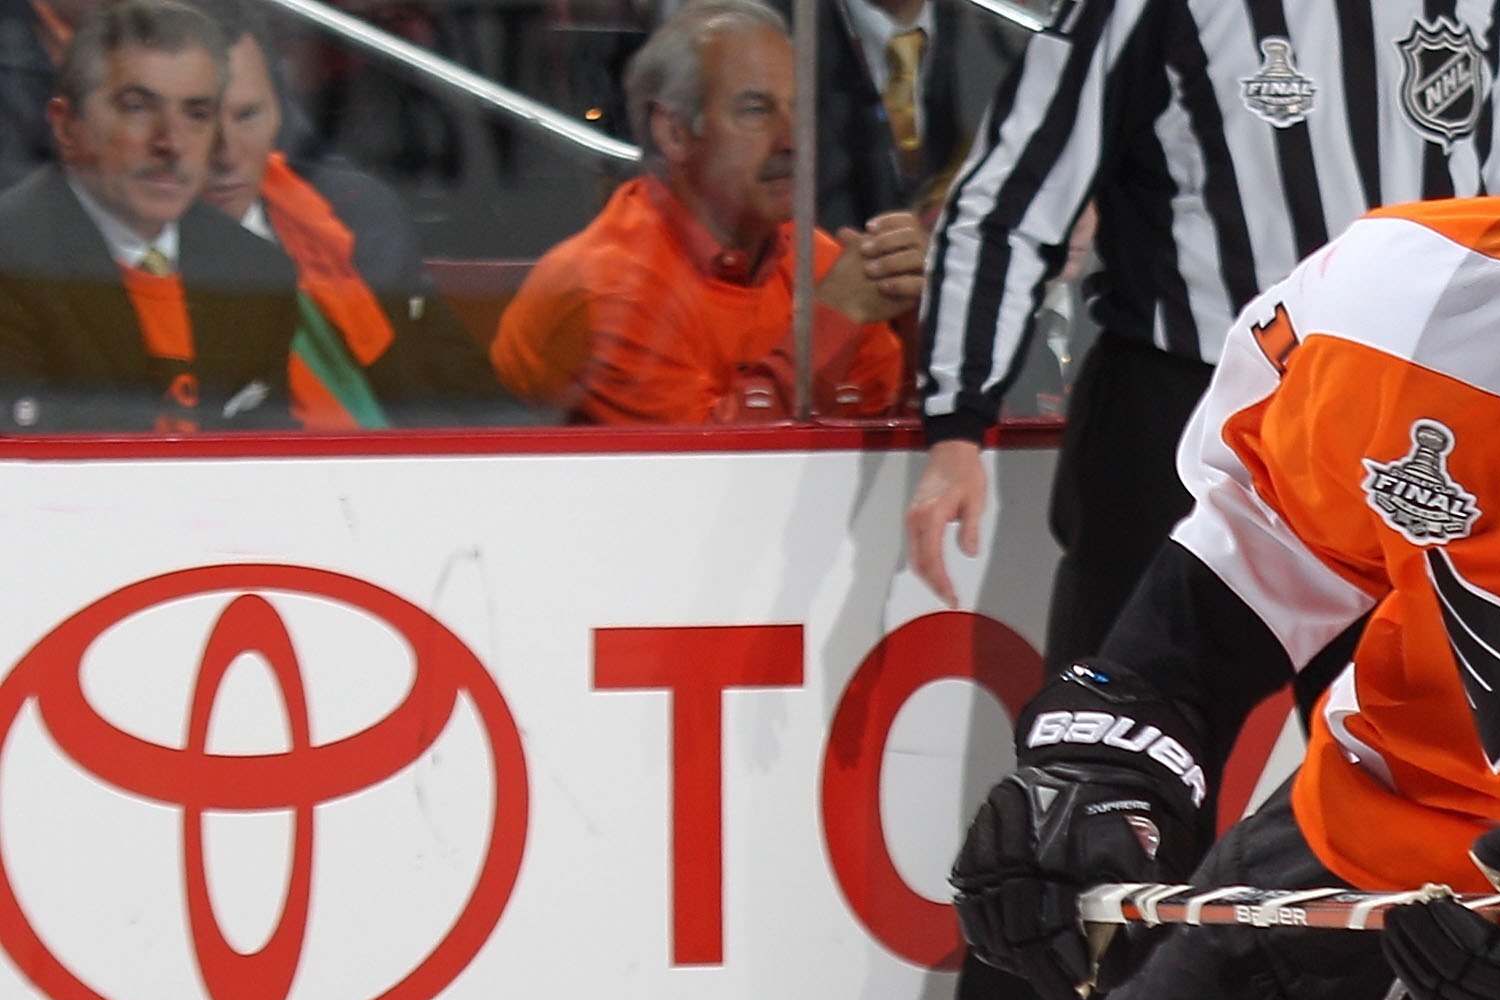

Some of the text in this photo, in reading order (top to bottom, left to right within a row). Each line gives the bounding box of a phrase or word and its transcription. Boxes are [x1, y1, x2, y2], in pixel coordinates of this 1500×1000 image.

[1248, 82, 1314, 96] FINAL
[1424, 62, 1471, 111] NHL
[1375, 473, 1468, 517] FINAL
